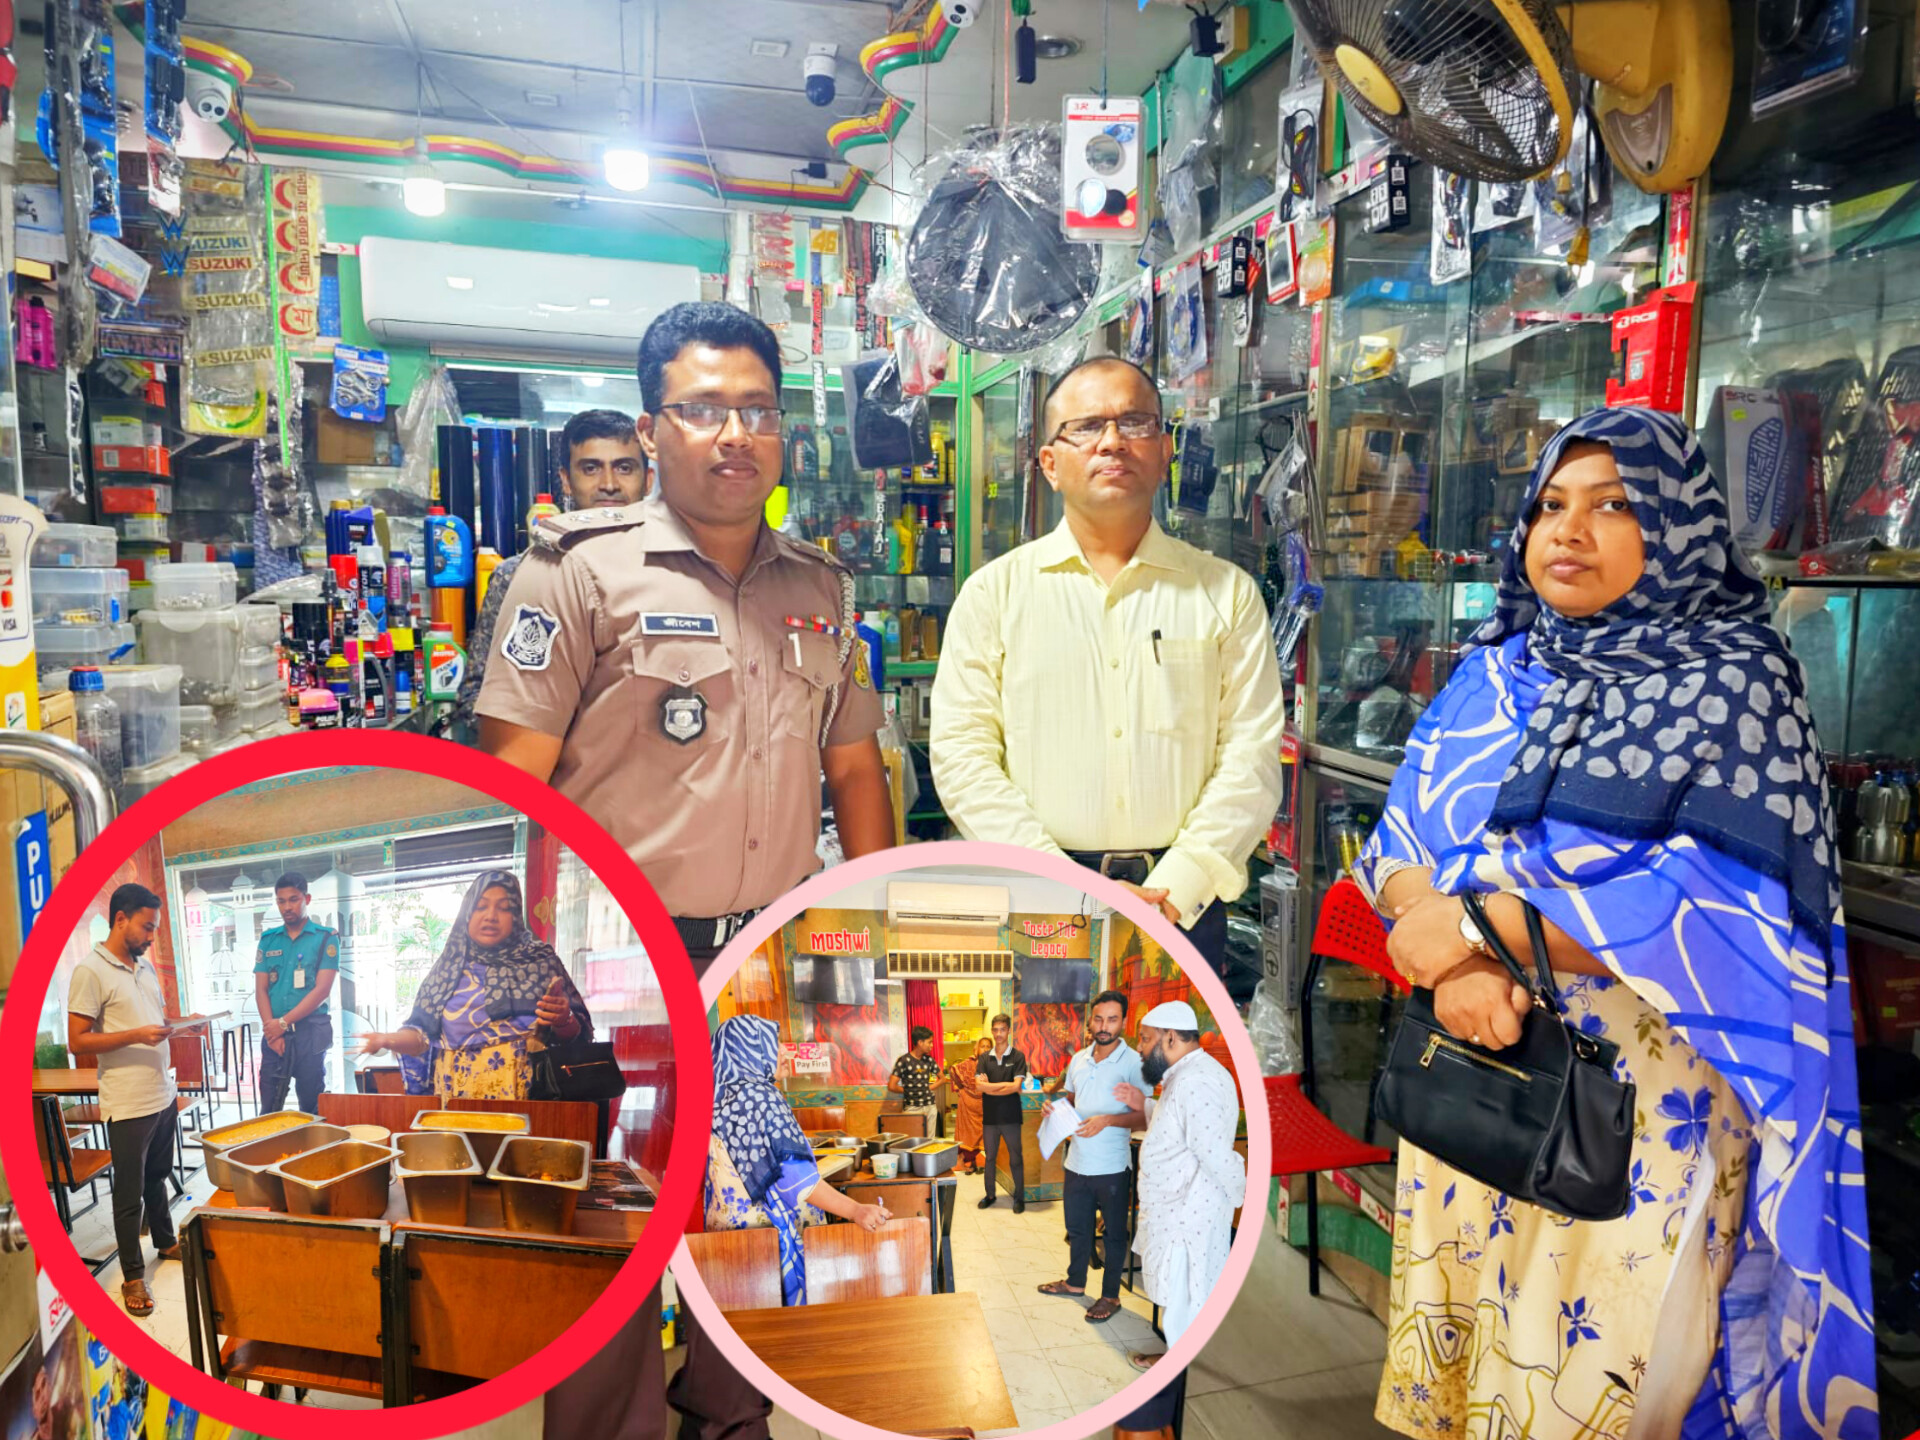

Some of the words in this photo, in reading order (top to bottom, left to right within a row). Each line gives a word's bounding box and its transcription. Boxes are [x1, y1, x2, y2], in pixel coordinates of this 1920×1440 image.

[188, 256, 252, 270] SUZUKI
[196, 293, 260, 309] SUZUKI
[209, 347, 274, 364] SUZUKI
[875, 502, 885, 554] BAJAJ
[796, 1061, 810, 1069] Pay
[812, 1060, 828, 1068] First
